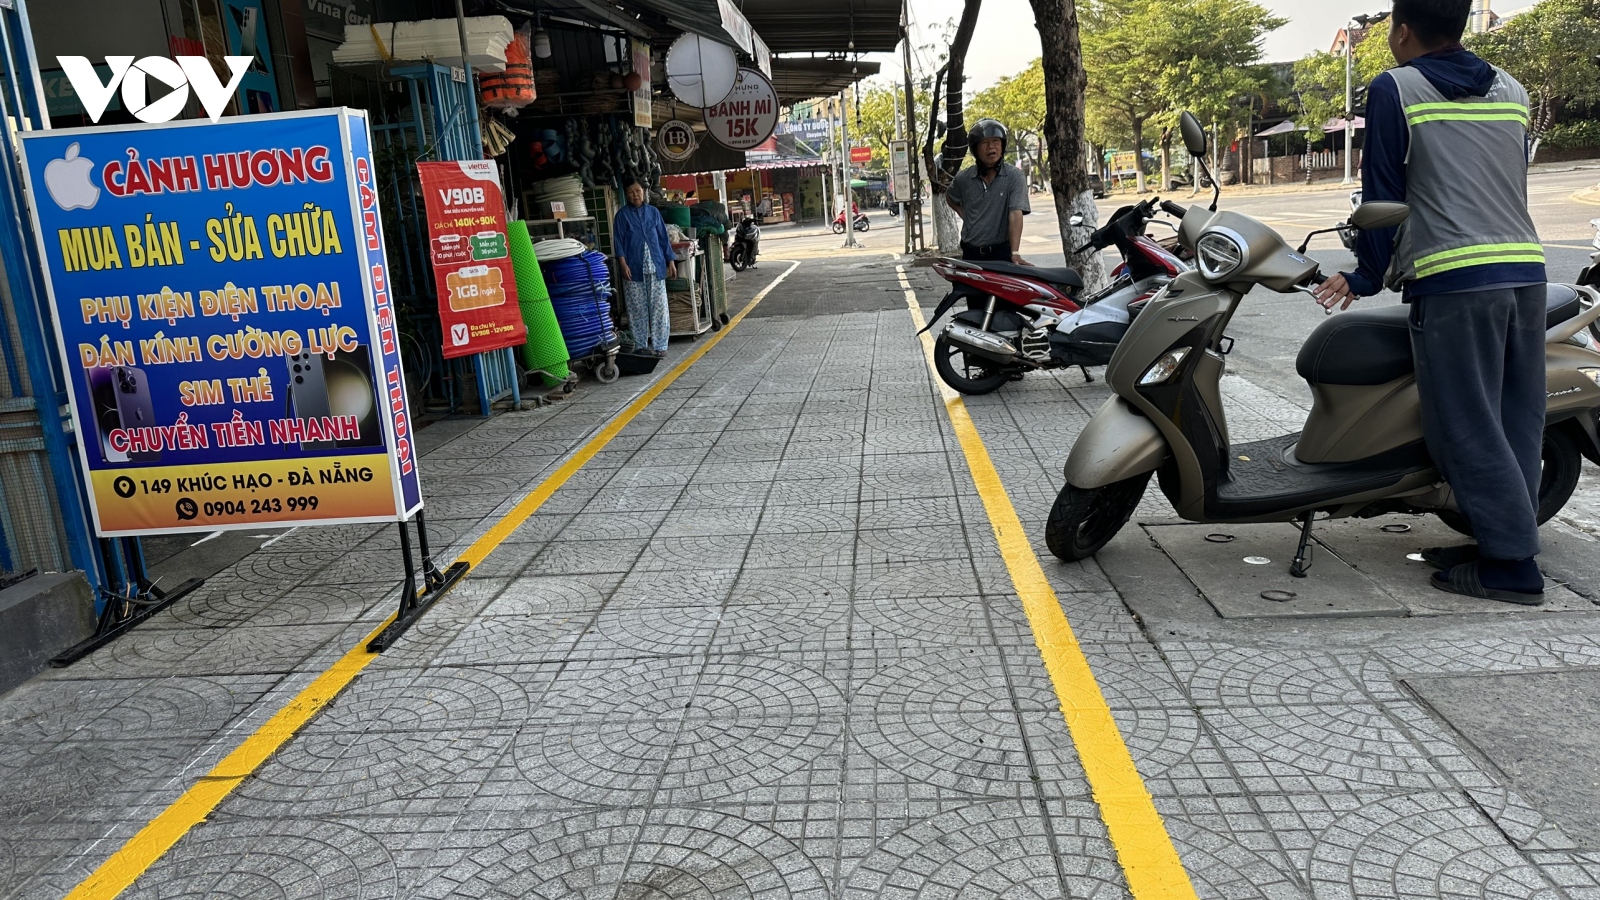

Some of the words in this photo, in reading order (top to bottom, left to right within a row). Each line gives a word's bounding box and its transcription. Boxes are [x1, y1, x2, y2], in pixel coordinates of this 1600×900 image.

[307, 0, 340, 19] Vina
[754, 94, 771, 115] MÌ
[667, 131, 687, 145] HB
[726, 118, 759, 137] 15K
[103, 148, 200, 196] CẢNH
[204, 146, 332, 189] HƯƠNG
[439, 187, 485, 206] V90B
[58, 226, 122, 272] MUA
[124, 213, 184, 268] BÁN
[189, 240, 200, 250] -
[206, 202, 264, 262] SỬA
[266, 202, 343, 258] CHỮA
[80, 296, 132, 329] PHỤ
[137, 286, 195, 326] KIỆN
[199, 282, 258, 321] ĐIỆN
[261, 282, 341, 316] THOẠI
[456, 284, 478, 299] 1GB
[79, 334, 136, 368] DÁN
[139, 331, 202, 364] KÍNH
[206, 326, 302, 356] CƯỜNG
[307, 324, 358, 360] LỰC
[371, 263, 395, 355] ĐIỆN
[387, 365, 412, 475] THOẠI
[179, 380, 224, 406] SIM
[228, 367, 273, 403] THẺ
[109, 412, 208, 453] CHUYỂN
[212, 409, 265, 447] TIỀN
[269, 415, 360, 443] NHANH
[141, 479, 171, 494] 149
[177, 472, 227, 493] KHÚC
[233, 473, 272, 493] HẠO
[288, 470, 314, 486] ĐÀ
[320, 462, 373, 484] NẴNG
[204, 501, 246, 516] 0904
[252, 498, 281, 514] 243
[287, 496, 319, 512] 999
